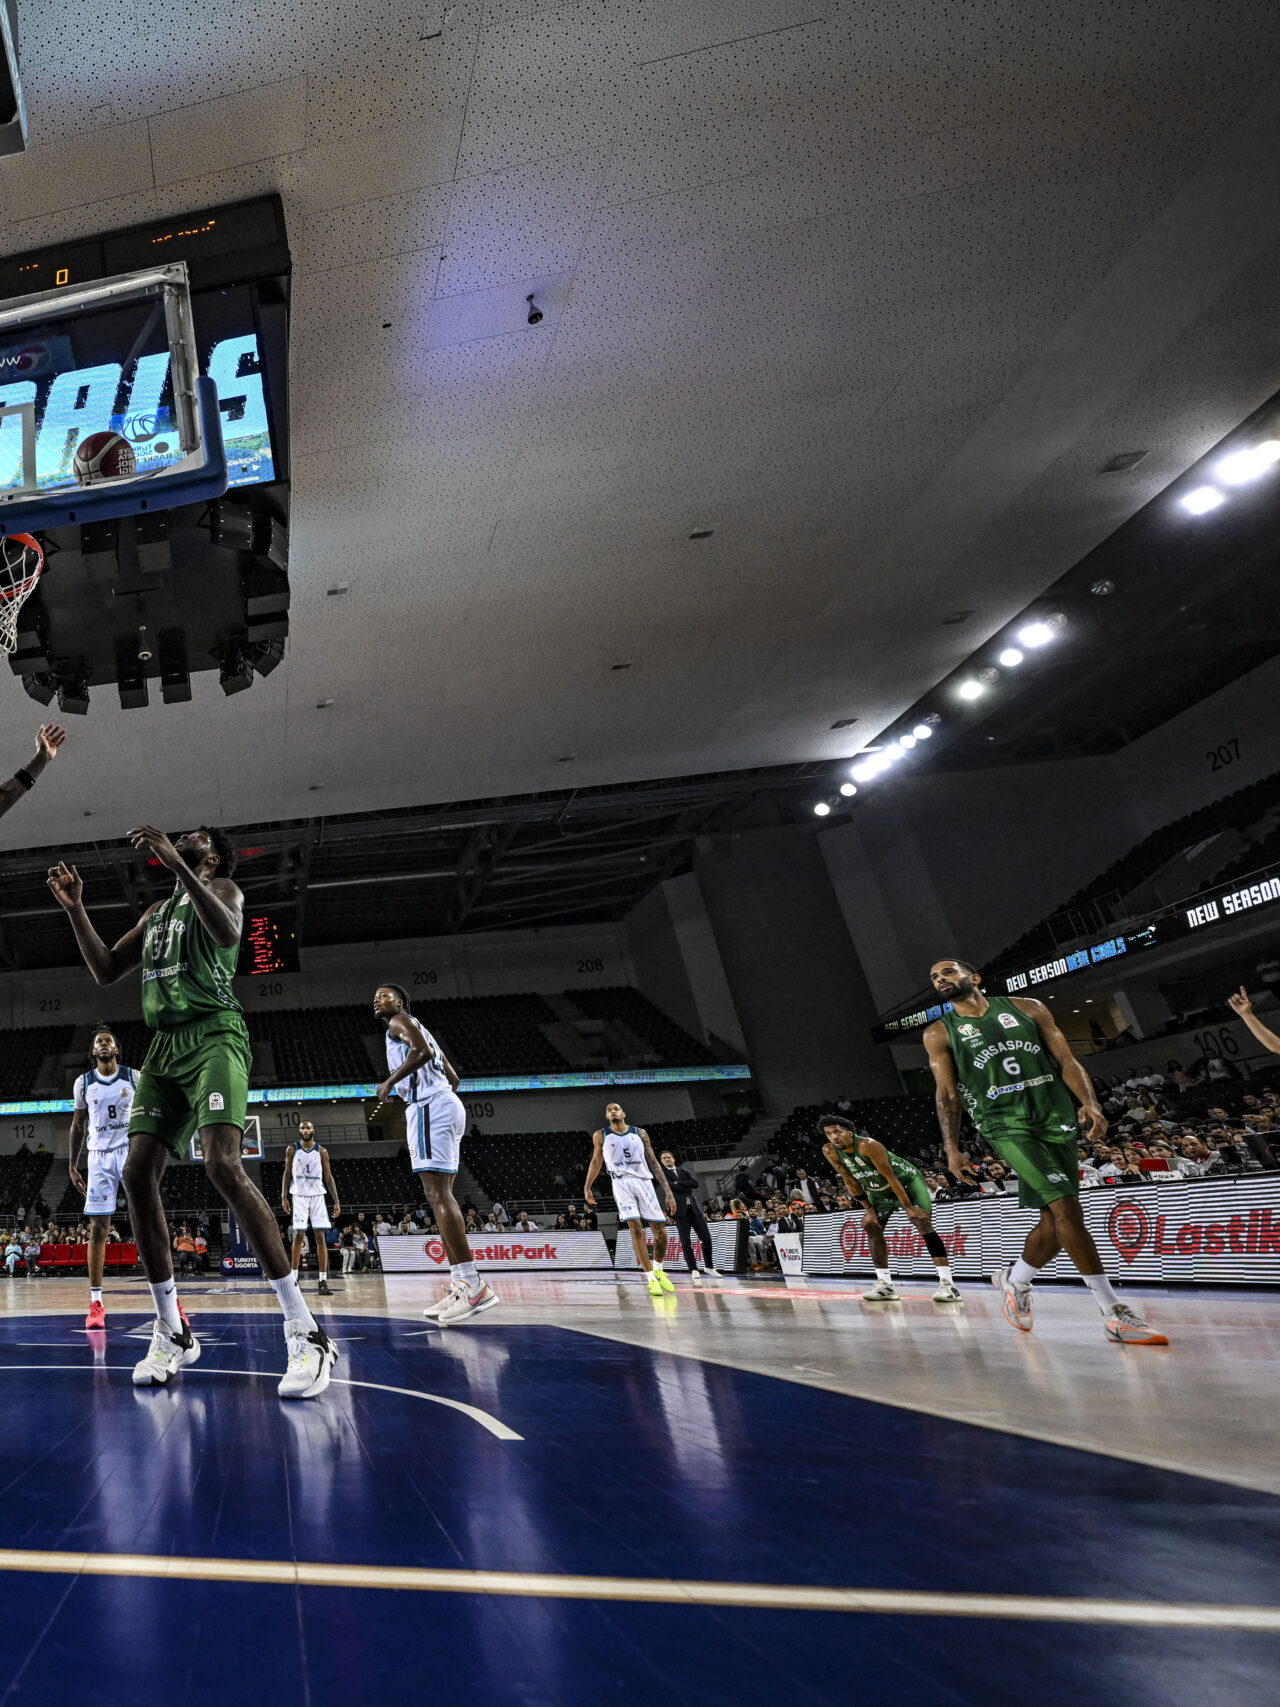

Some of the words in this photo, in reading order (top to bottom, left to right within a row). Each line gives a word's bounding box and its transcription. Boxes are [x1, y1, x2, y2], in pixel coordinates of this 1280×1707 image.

[1206, 738, 1240, 772] 207
[1186, 900, 1220, 928] NEW
[1222, 876, 1280, 915] SEASON
[576, 959, 605, 973] 208
[412, 971, 438, 985] 209
[1006, 972, 1028, 993] NEW
[1028, 958, 1068, 985] SEASON
[259, 983, 283, 997] 210
[40, 1000, 62, 1012] 212
[900, 1010, 928, 1030] SEASON
[1193, 1027, 1240, 1057] 106
[973, 1040, 1041, 1070] BURSASPOR
[1002, 1056, 1021, 1075] 6
[108, 1104, 117, 1119] 8
[466, 1102, 494, 1118] 109
[277, 1111, 300, 1126] 110
[13, 1125, 35, 1139] 112
[623, 1148, 631, 1158] 5
[306, 1164, 310, 1174] 1
